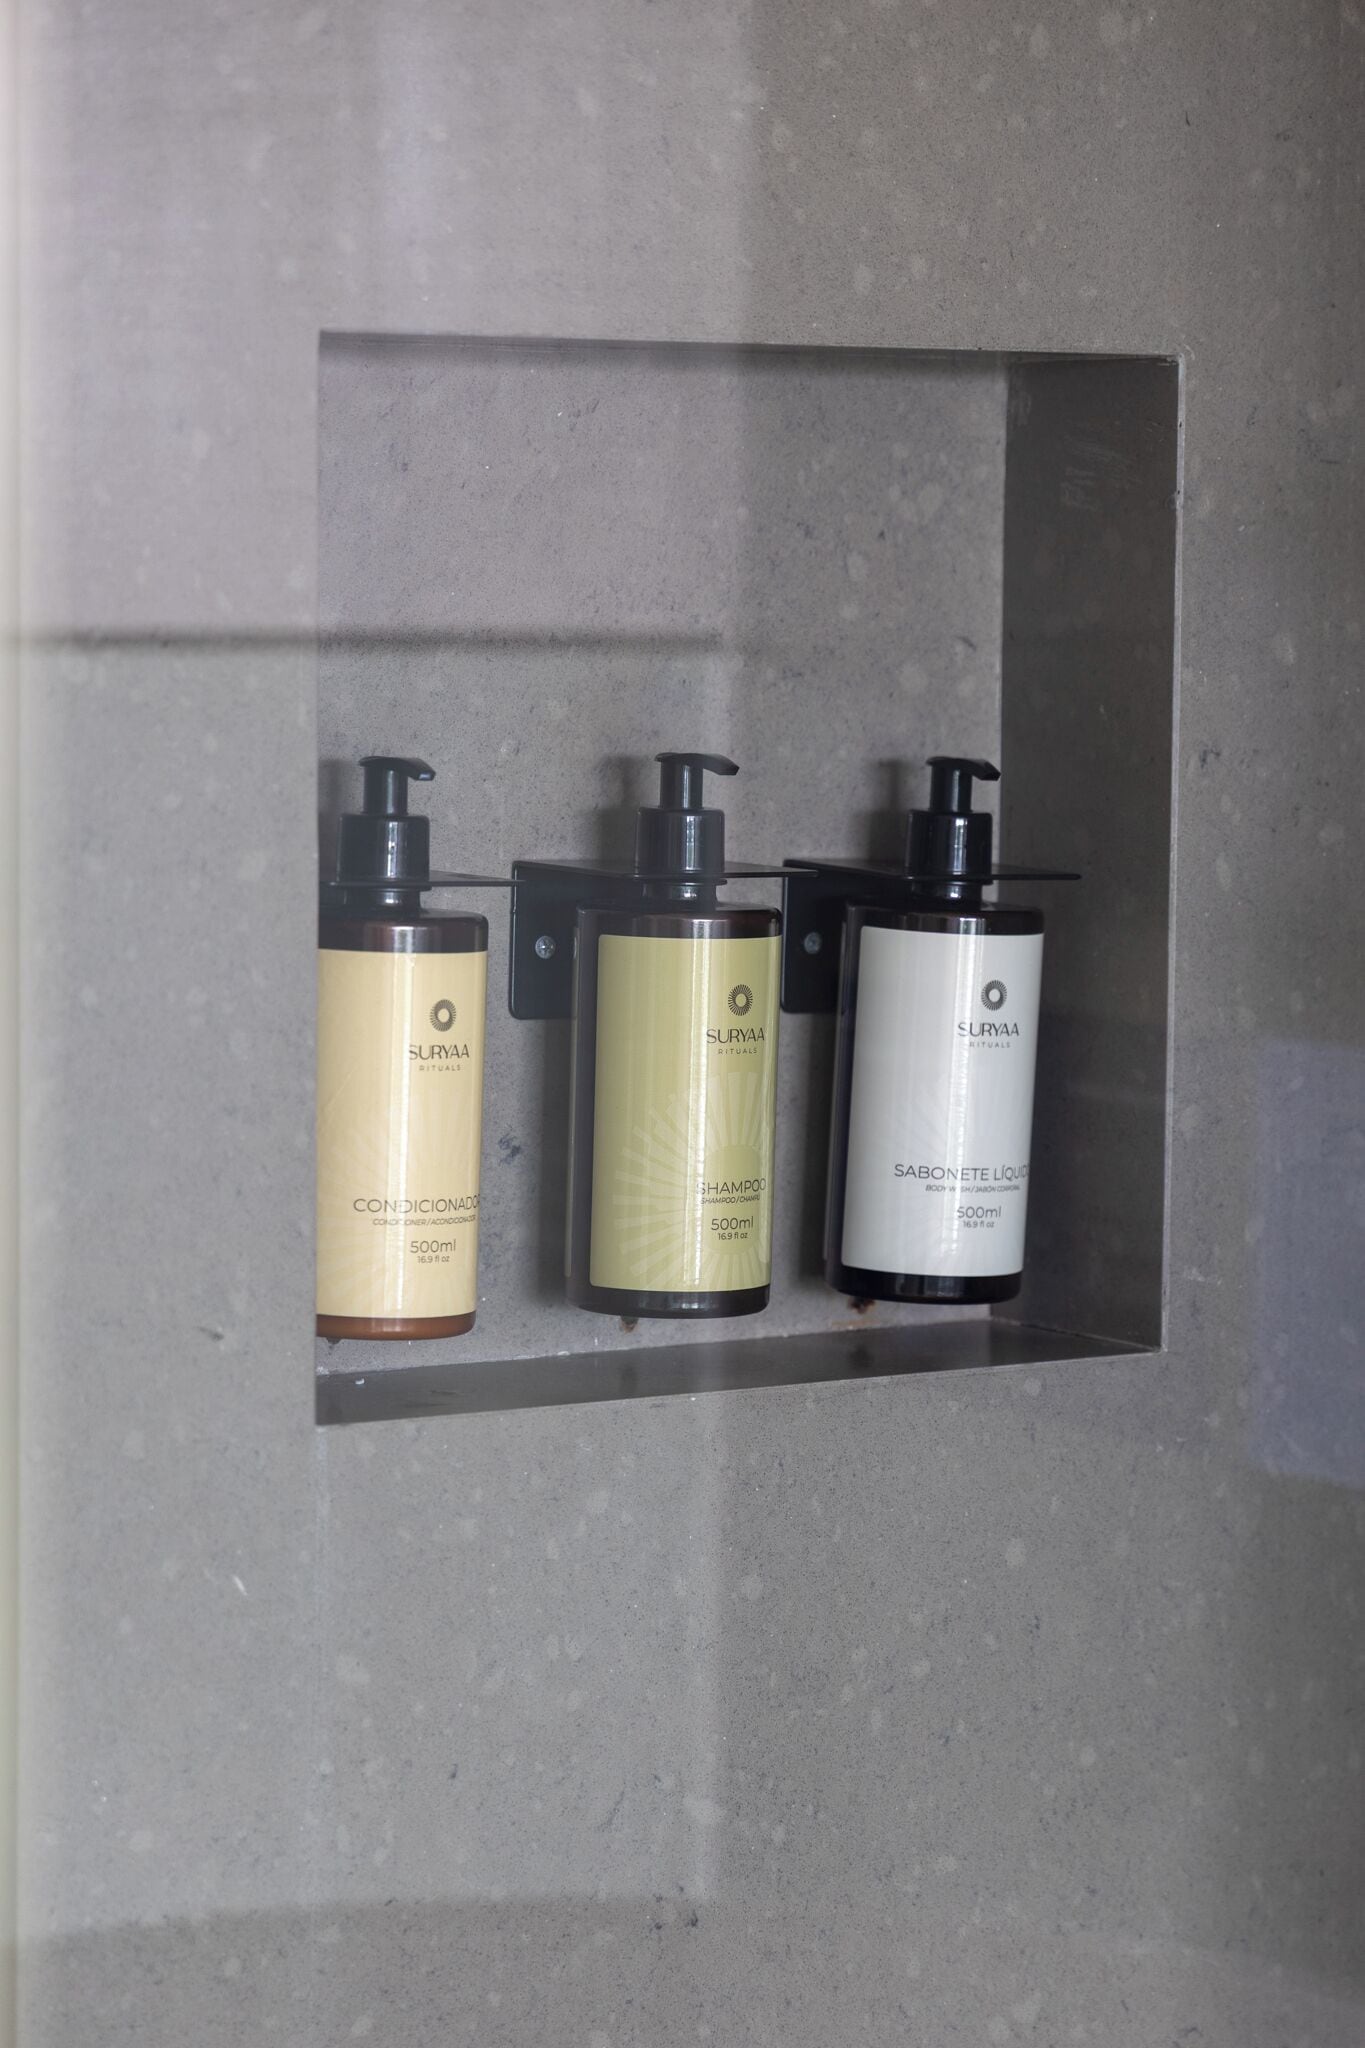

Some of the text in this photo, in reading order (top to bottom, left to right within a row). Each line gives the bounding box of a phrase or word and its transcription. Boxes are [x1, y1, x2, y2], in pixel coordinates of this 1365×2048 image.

[706, 1027, 765, 1044] SURYAA
[957, 1021, 1020, 1037] SURYAA
[408, 1043, 470, 1060] SURYAA
[717, 1047, 758, 1055] RITUALS
[969, 1041, 1011, 1049] RITUALS
[418, 1064, 462, 1072] RITUALS
[894, 1163, 990, 1182] SABONETE
[696, 1178, 767, 1195] SHAMPOO
[957, 1206, 1002, 1219] 500ml
[710, 1216, 754, 1231] 500ml
[962, 1220, 978, 1229] 16.9
[985, 1220, 995, 1229] oz
[718, 1232, 733, 1240] 16.9
[410, 1239, 457, 1254] 500ml
[417, 1255, 434, 1264] 16.9
[441, 1255, 451, 1263] oz
